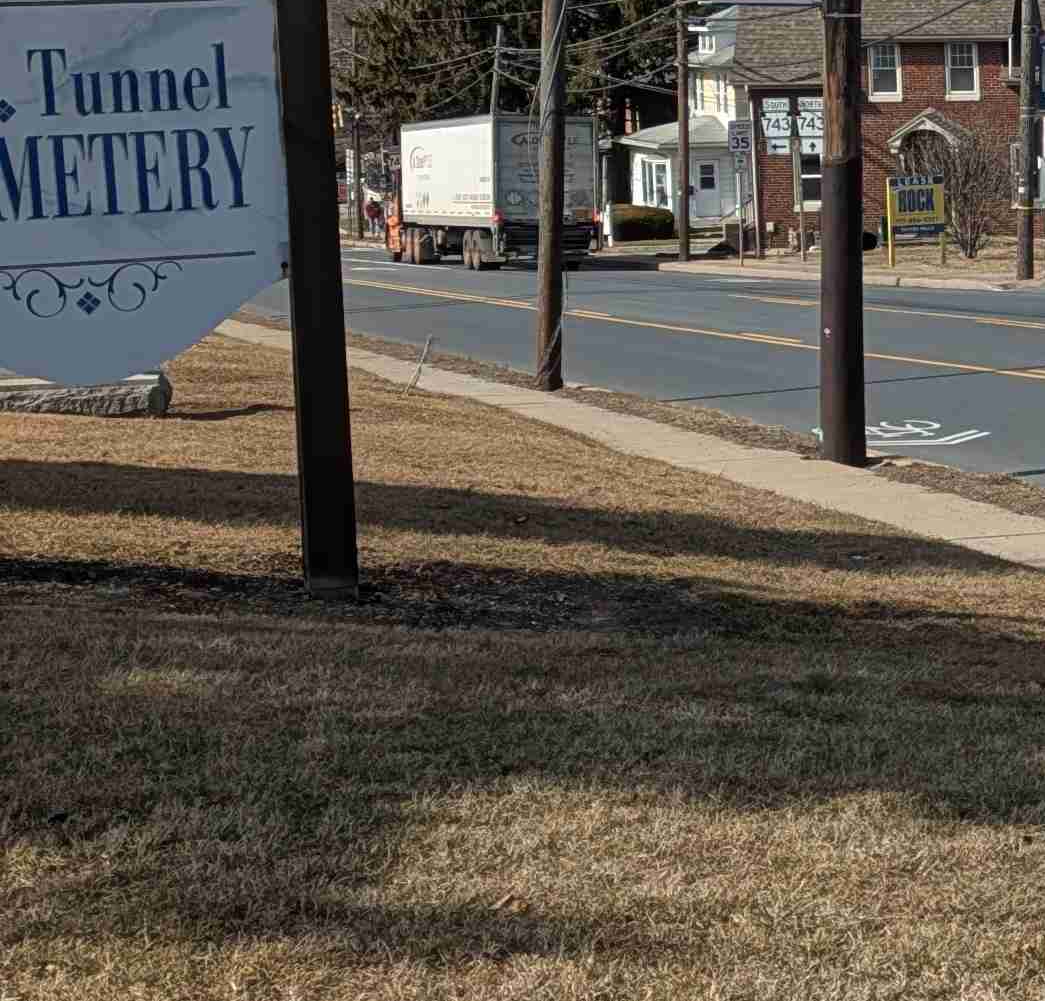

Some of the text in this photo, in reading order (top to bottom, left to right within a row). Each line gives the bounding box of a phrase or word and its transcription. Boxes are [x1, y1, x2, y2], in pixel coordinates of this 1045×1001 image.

[27, 42, 232, 117] Tunnel
[764, 117, 791, 132] 743
[800, 116, 824, 131] 743
[731, 136, 750, 150] 35
[0, 125, 255, 222] METERY
